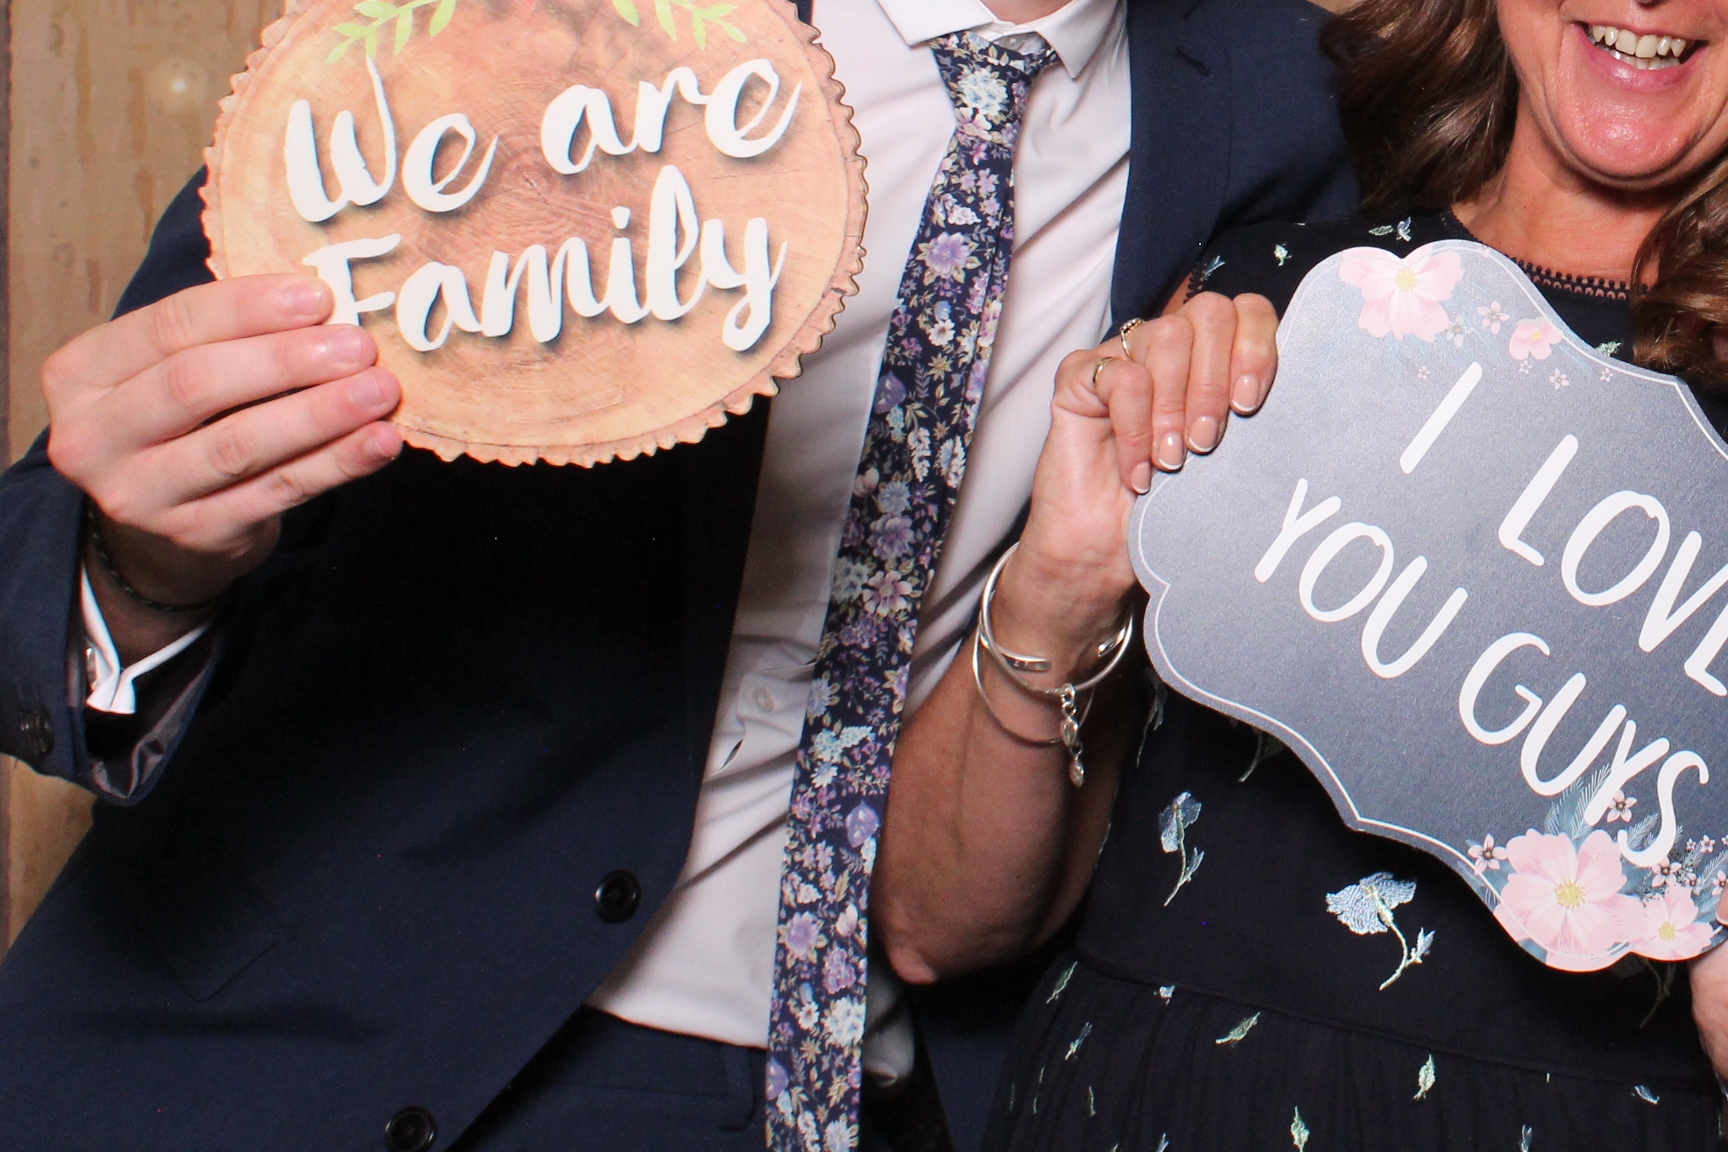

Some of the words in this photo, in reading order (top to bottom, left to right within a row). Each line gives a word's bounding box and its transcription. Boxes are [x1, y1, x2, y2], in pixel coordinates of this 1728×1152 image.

[284, 56, 498, 223] We
[540, 58, 802, 175] are
[302, 164, 788, 352] Family
[1399, 361, 1483, 475] I
[1254, 478, 1468, 679] YOU
[1458, 631, 1710, 868] GUYS
